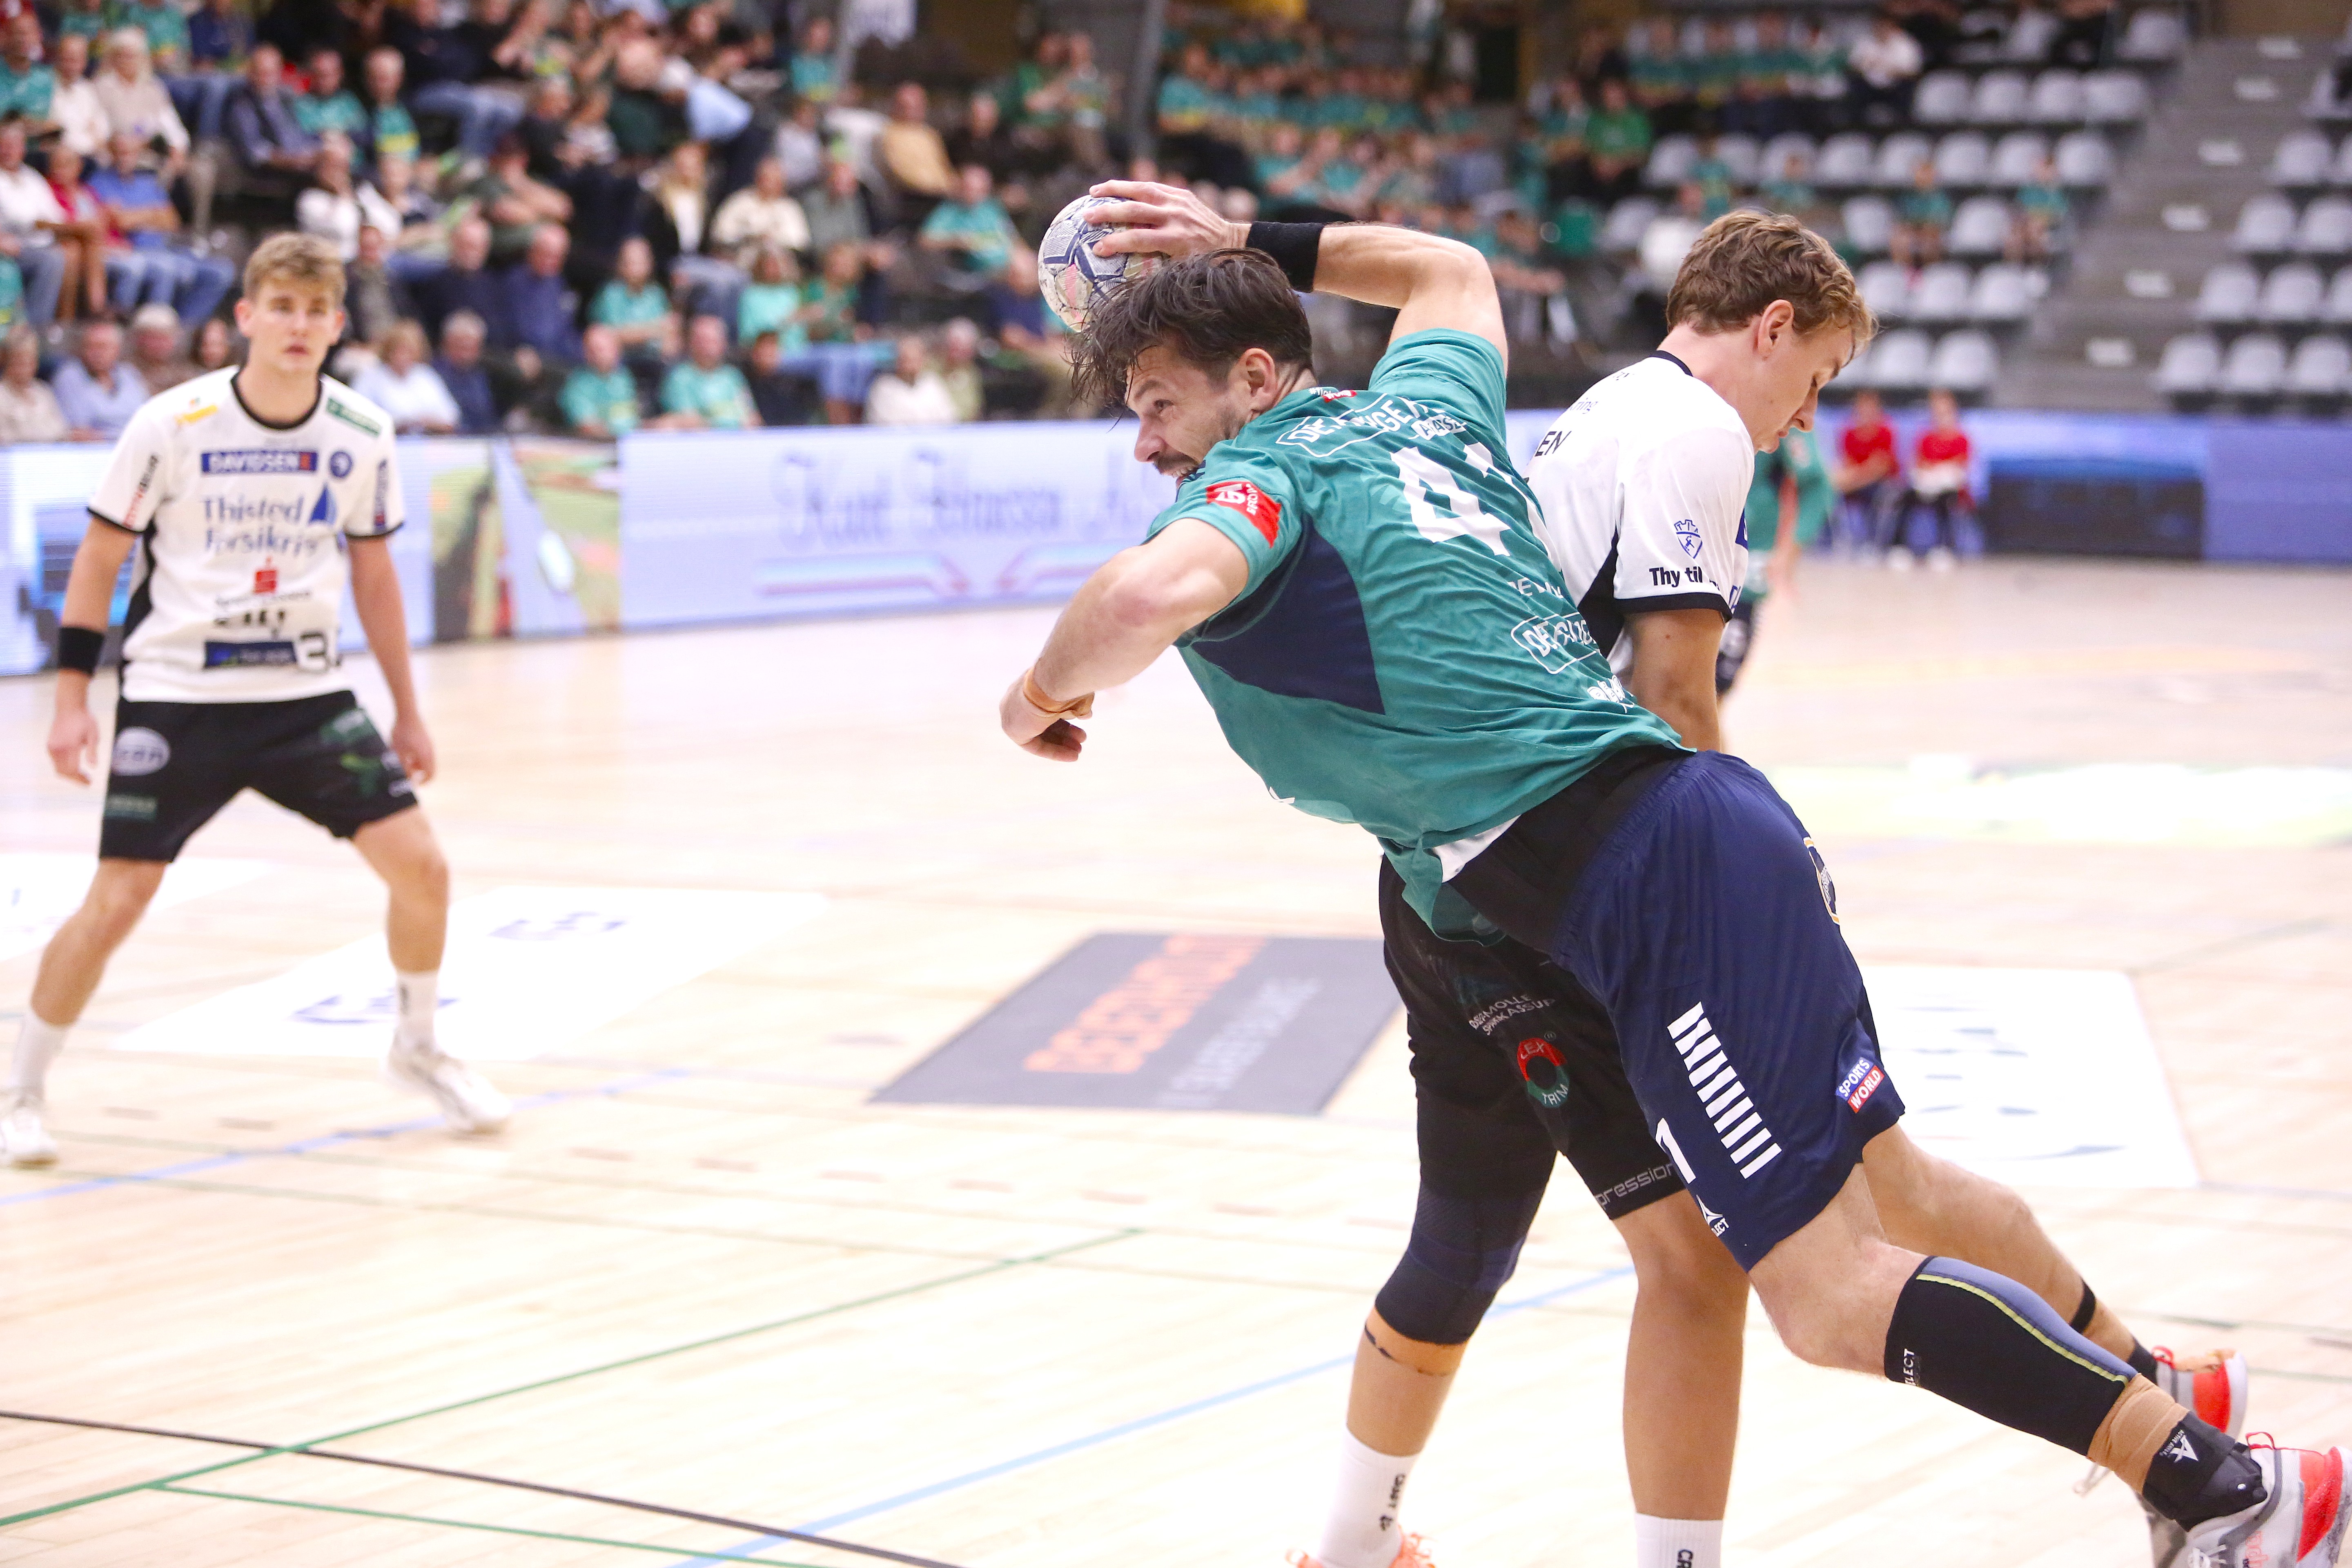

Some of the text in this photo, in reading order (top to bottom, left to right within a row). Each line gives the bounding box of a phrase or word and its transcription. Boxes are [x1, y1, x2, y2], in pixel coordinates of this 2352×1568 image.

[203, 495, 305, 523] Thisted
[1649, 566, 1703, 588] Thy til
[1839, 1060, 1870, 1097] SPORTS
[1851, 1069, 1881, 1109] WORLD
[1541, 1084, 1569, 1105] TRIM
